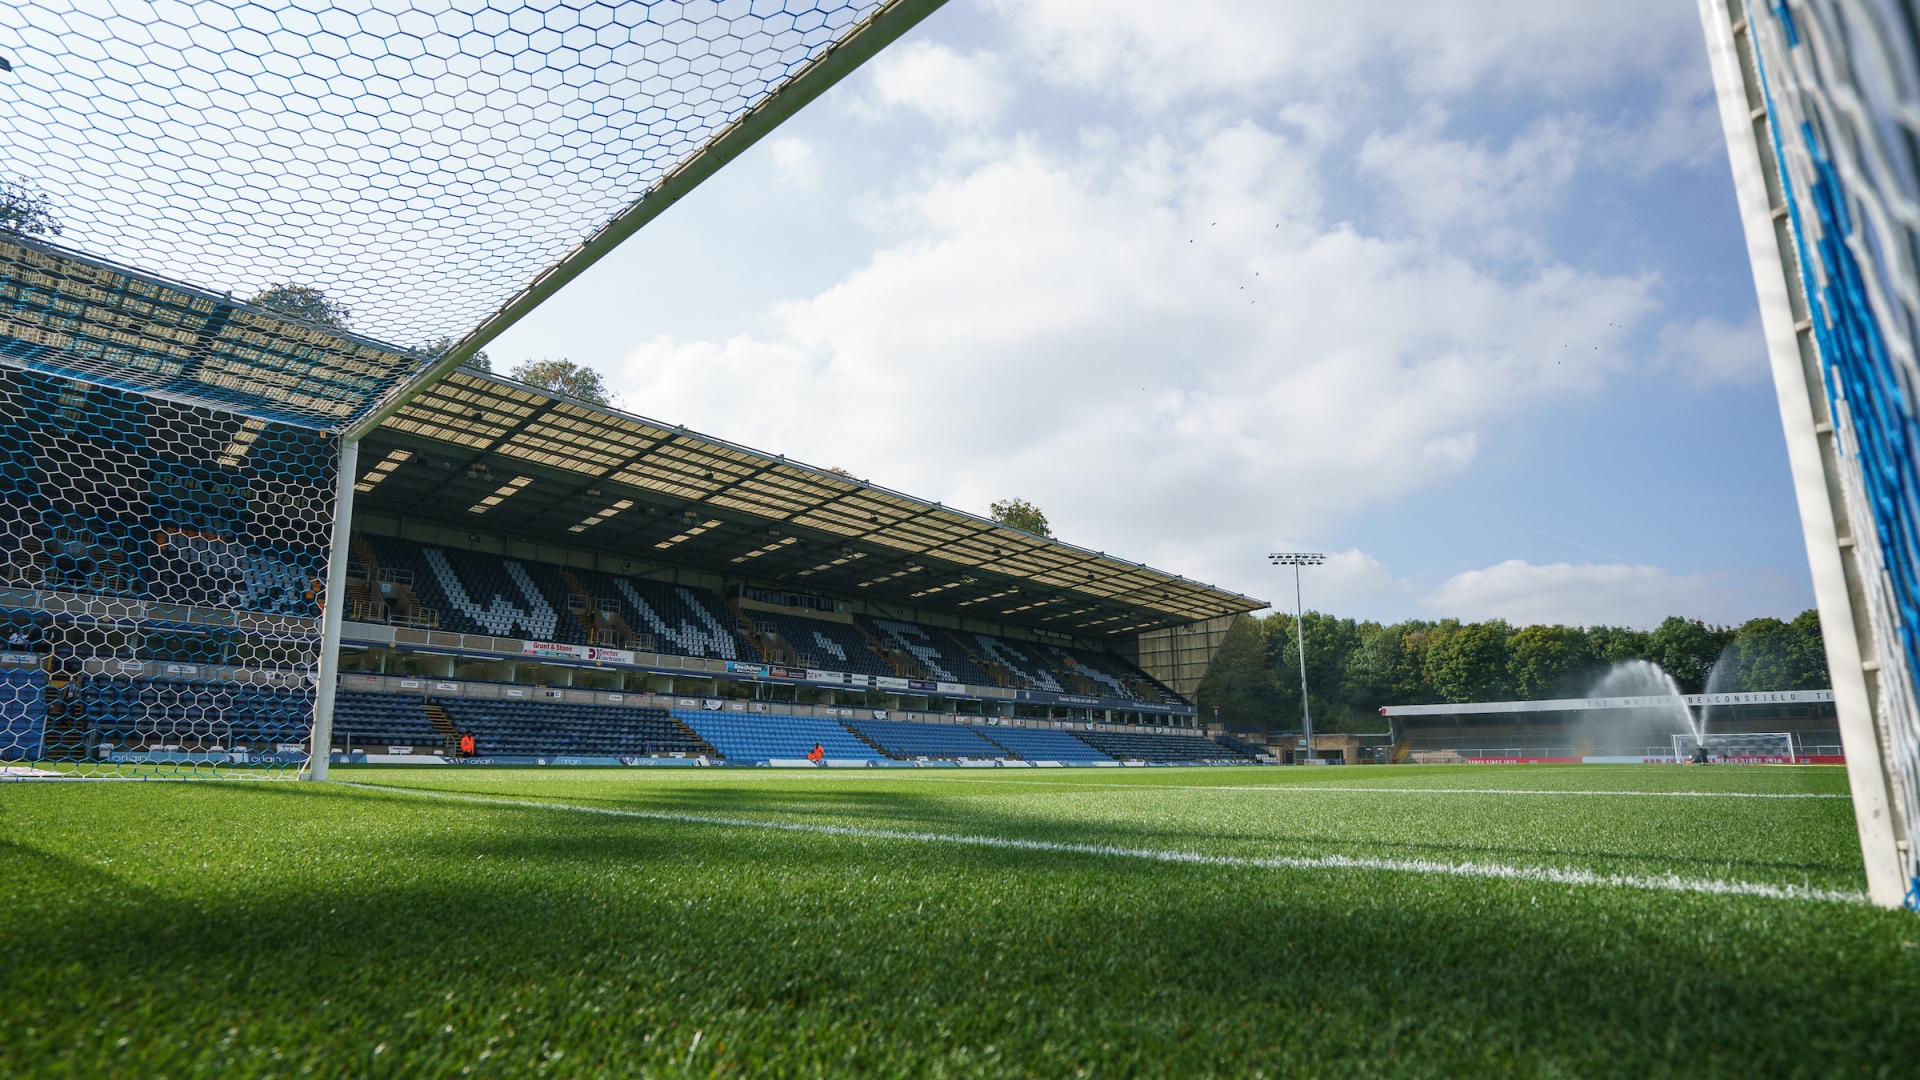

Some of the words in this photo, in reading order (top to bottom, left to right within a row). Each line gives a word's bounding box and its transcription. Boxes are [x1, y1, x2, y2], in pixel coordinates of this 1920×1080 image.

[746, 587, 790, 607] WYCOMBE
[533, 642, 550, 650] Grant
[599, 648, 619, 657] Deeter
[598, 655, 626, 663] Electronics
[1623, 698, 1670, 706] WHITES
[1688, 693, 1796, 704] BEACONSFIELD
